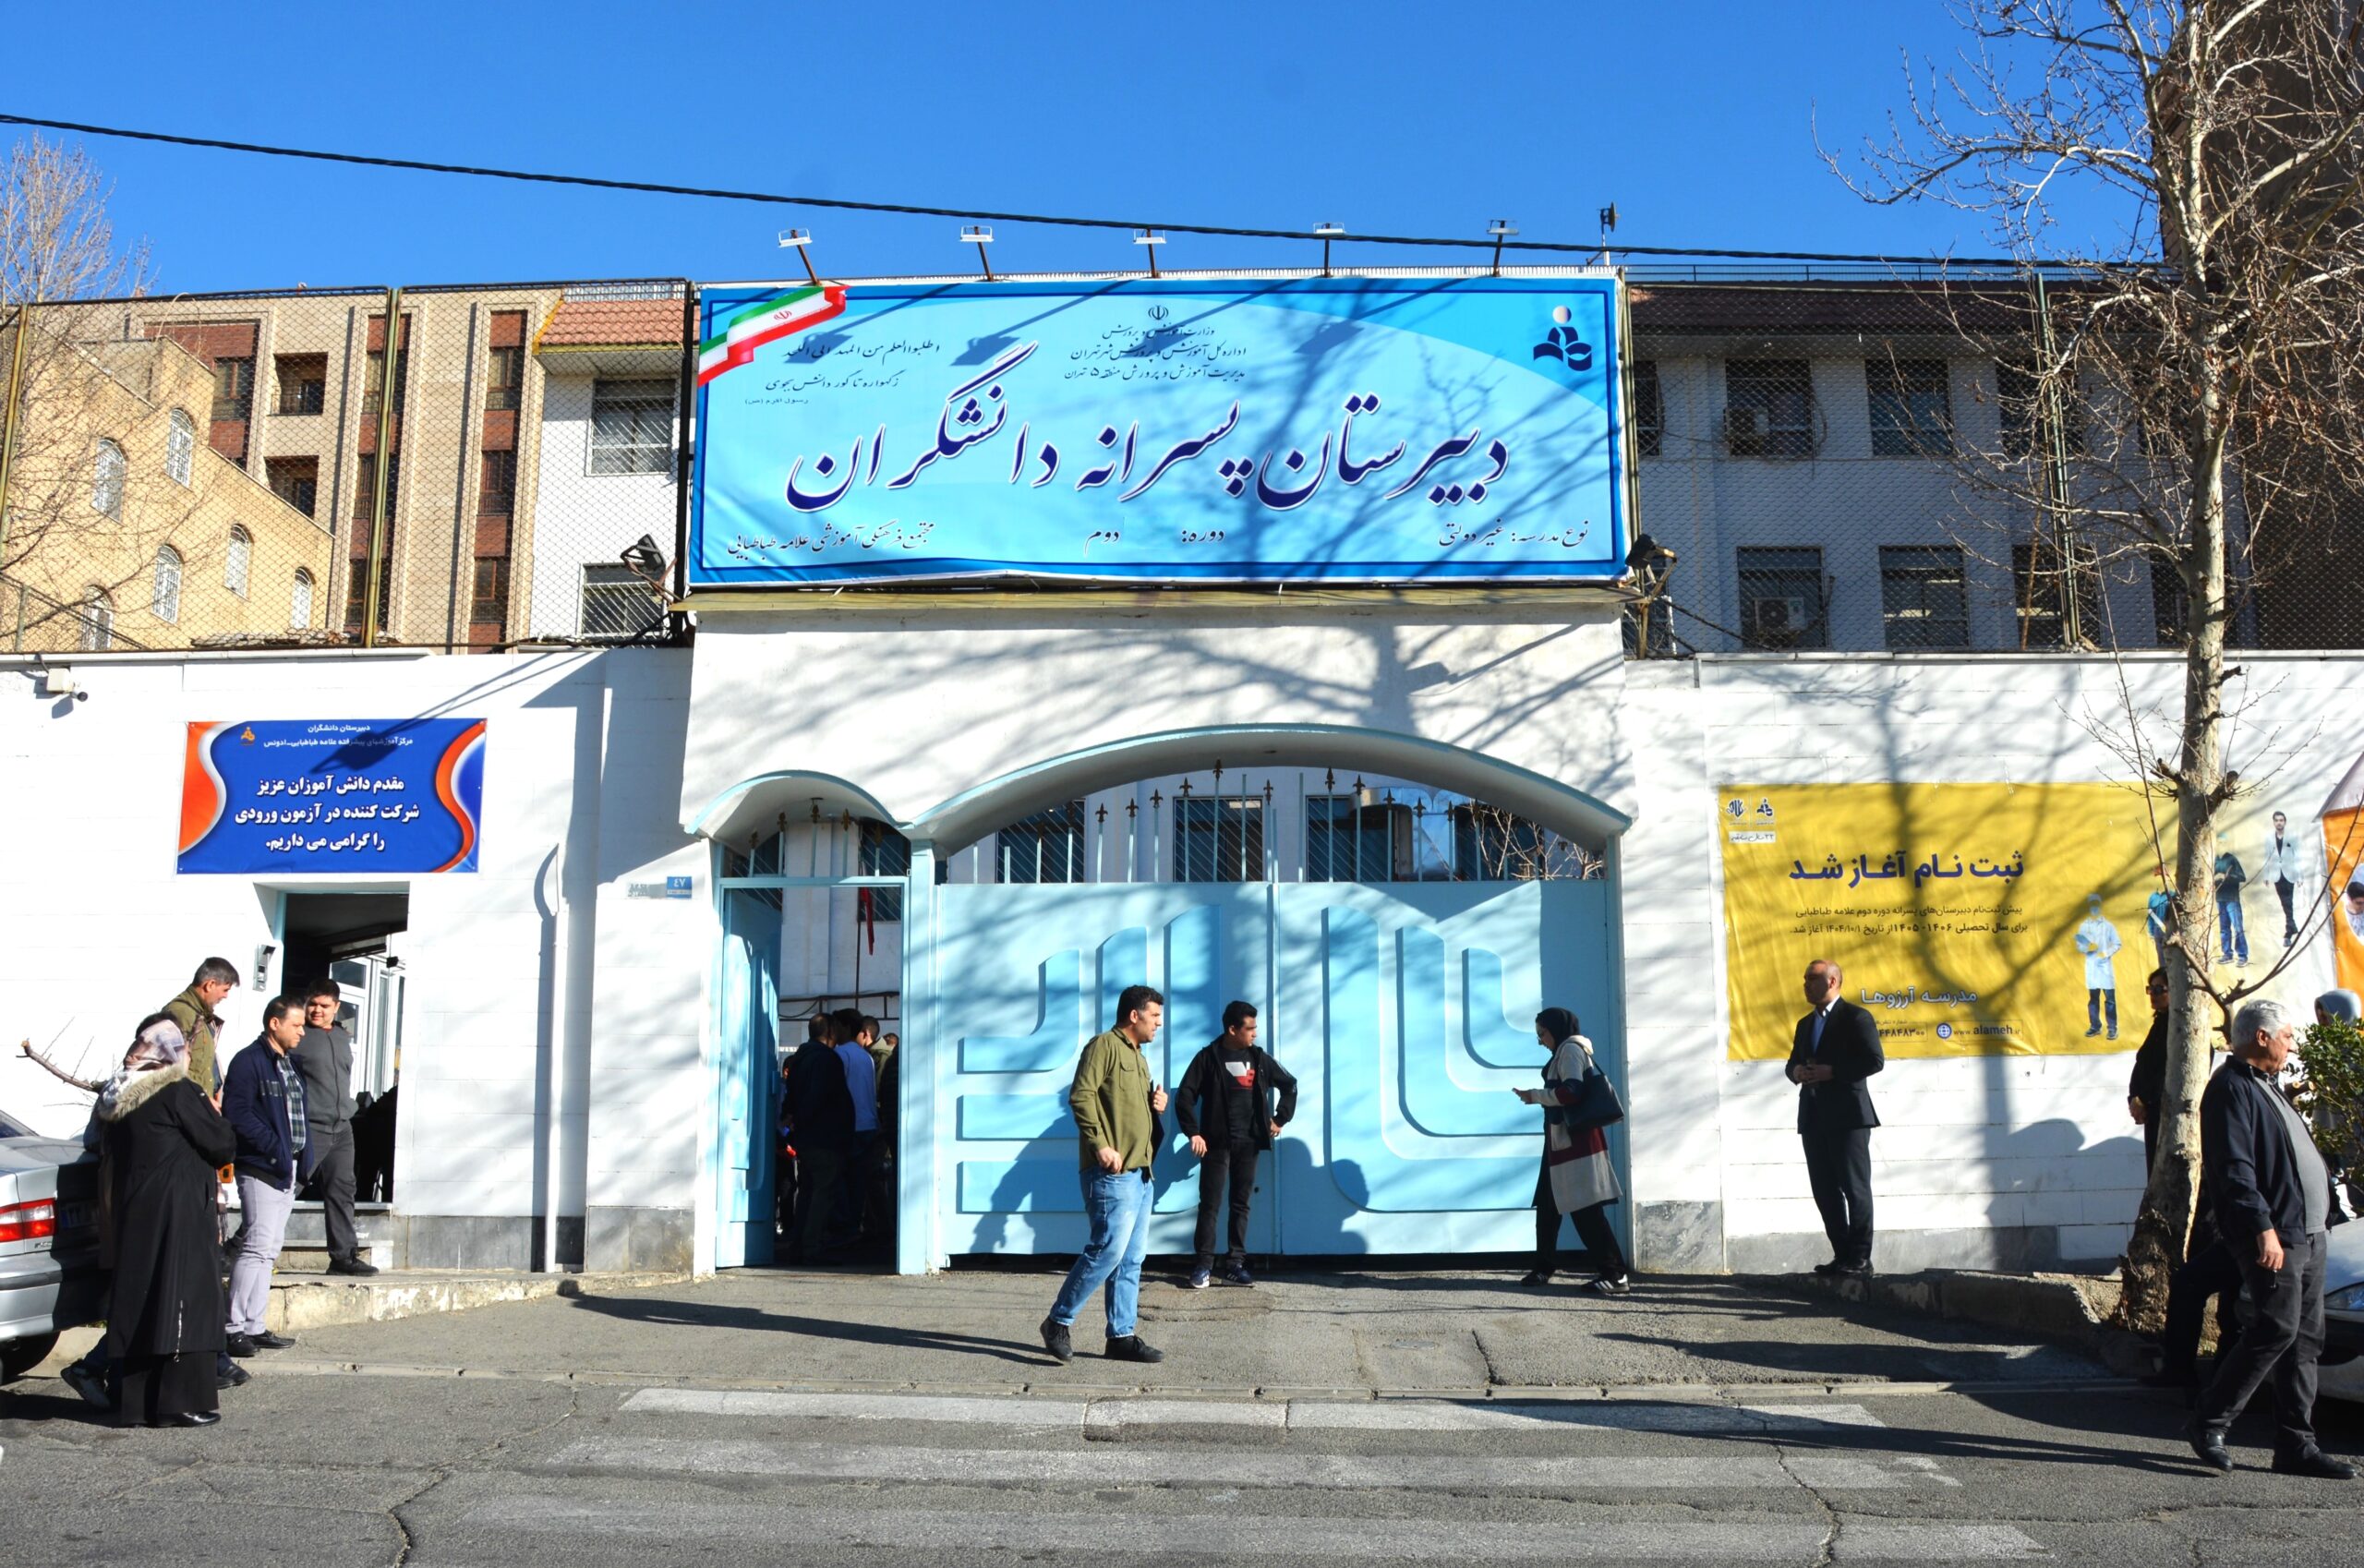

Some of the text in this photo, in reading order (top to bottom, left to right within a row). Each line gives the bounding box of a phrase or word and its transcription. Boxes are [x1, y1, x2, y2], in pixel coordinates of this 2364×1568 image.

[862, 345, 885, 358] من
[1162, 341, 1211, 360] آموزش
[1099, 368, 1121, 380] منطقه
[1122, 364, 1160, 380] پرورش
[1169, 363, 1211, 380] آموزش
[1207, 367, 1246, 382] مدیریت
[787, 341, 1509, 512] دبیرستان پسرانه دانشگران
[1562, 520, 1589, 548] نوع
[778, 535, 809, 550] علامه
[1084, 530, 1119, 556] دوم
[308, 723, 371, 733] دبیرستان دانشگران
[398, 737, 413, 746] مرکز
[257, 775, 404, 796] مقدم دانش آموزان عزیز
[235, 802, 420, 824] شرکت کننده در آزمون ورودی
[306, 837, 327, 851] می
[329, 832, 371, 851] گرامی
[373, 832, 385, 851] را
[1789, 850, 2024, 888] ثبت نام آغاز شد
[1795, 907, 1832, 918] طباطبایی
[1834, 907, 1854, 915] علامه
[1856, 908, 1872, 917] دوم
[1873, 908, 1890, 917] دوره
[1891, 906, 1918, 917] پسرانه
[2001, 905, 2023, 915] پیش
[1808, 923, 1824, 935] آغاز
[1863, 923, 1885, 935] تاریخ
[1955, 923, 1989, 935] تحصیلی
[1991, 923, 2009, 934] سال
[2010, 923, 2028, 934] برای
[1860, 985, 1978, 1009] مدرسه آرزوها
